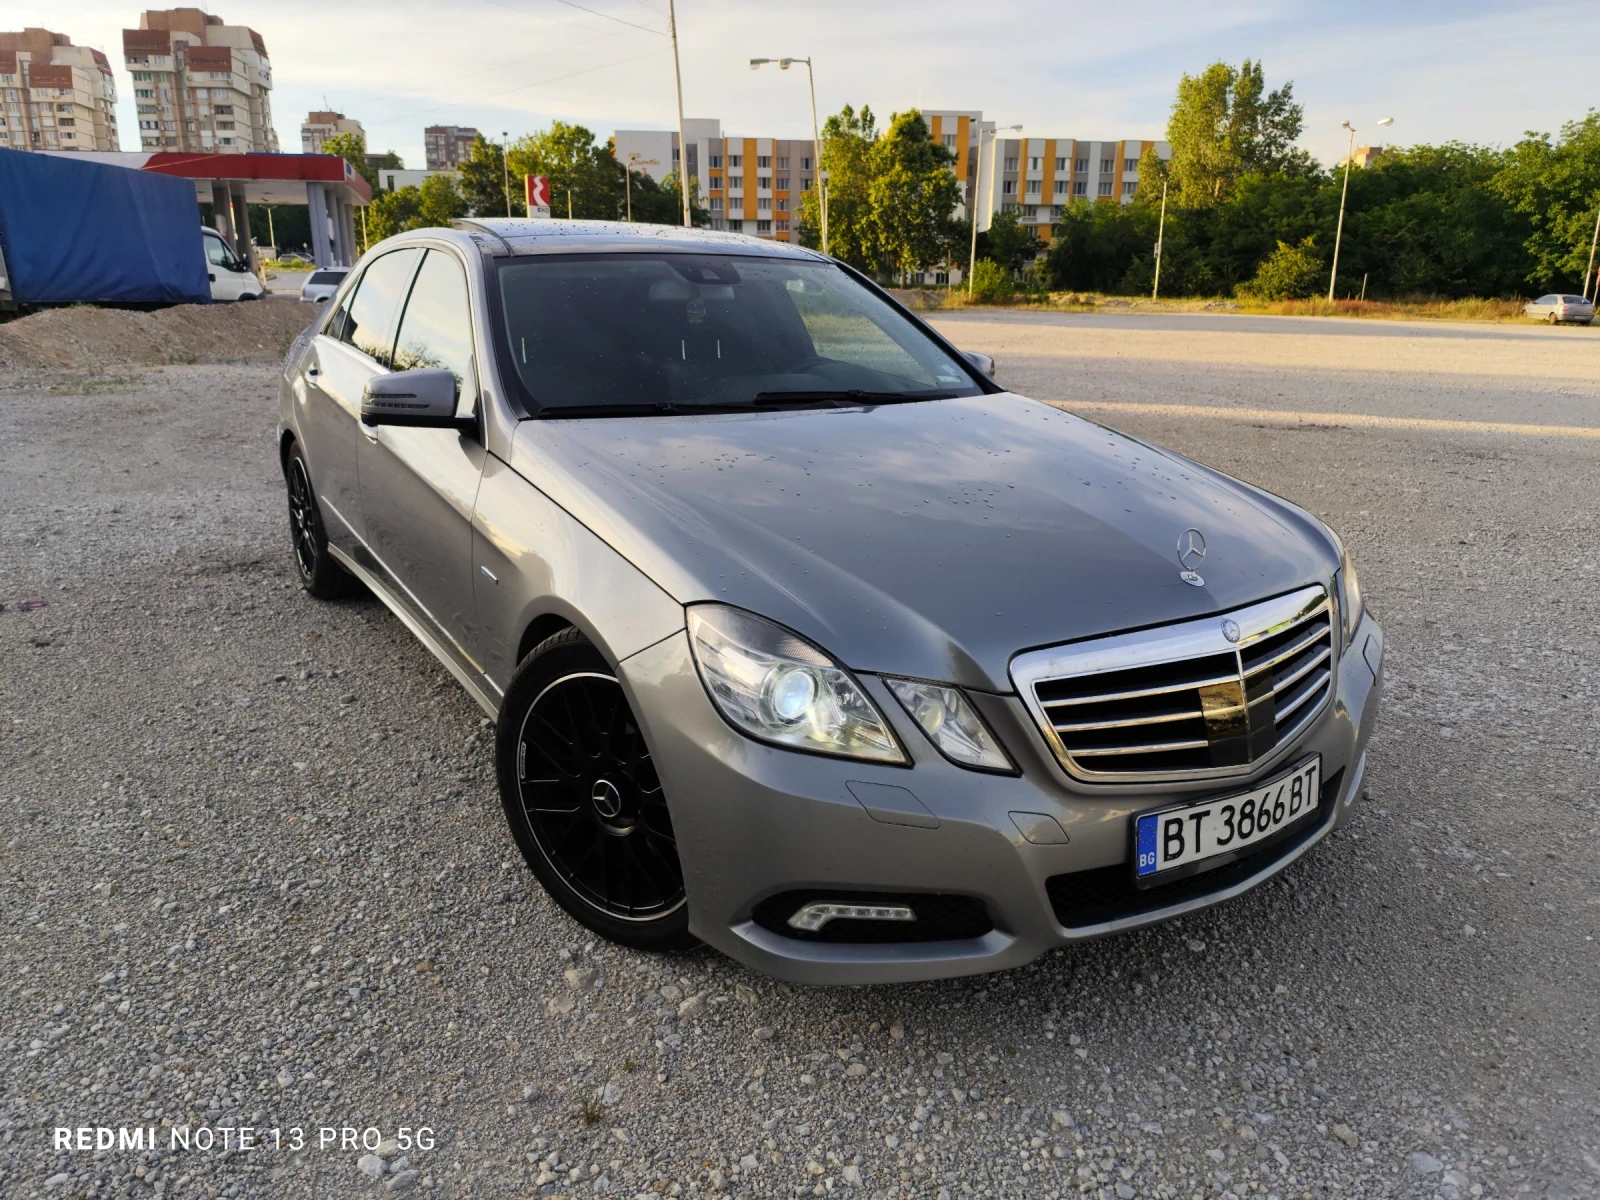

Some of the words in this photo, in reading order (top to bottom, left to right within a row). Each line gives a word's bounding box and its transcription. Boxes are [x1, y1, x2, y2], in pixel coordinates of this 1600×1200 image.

[1163, 809, 1211, 862] BT
[1216, 784, 1286, 846] 3866
[1288, 764, 1317, 818] BT
[1139, 851, 1155, 867] BG
